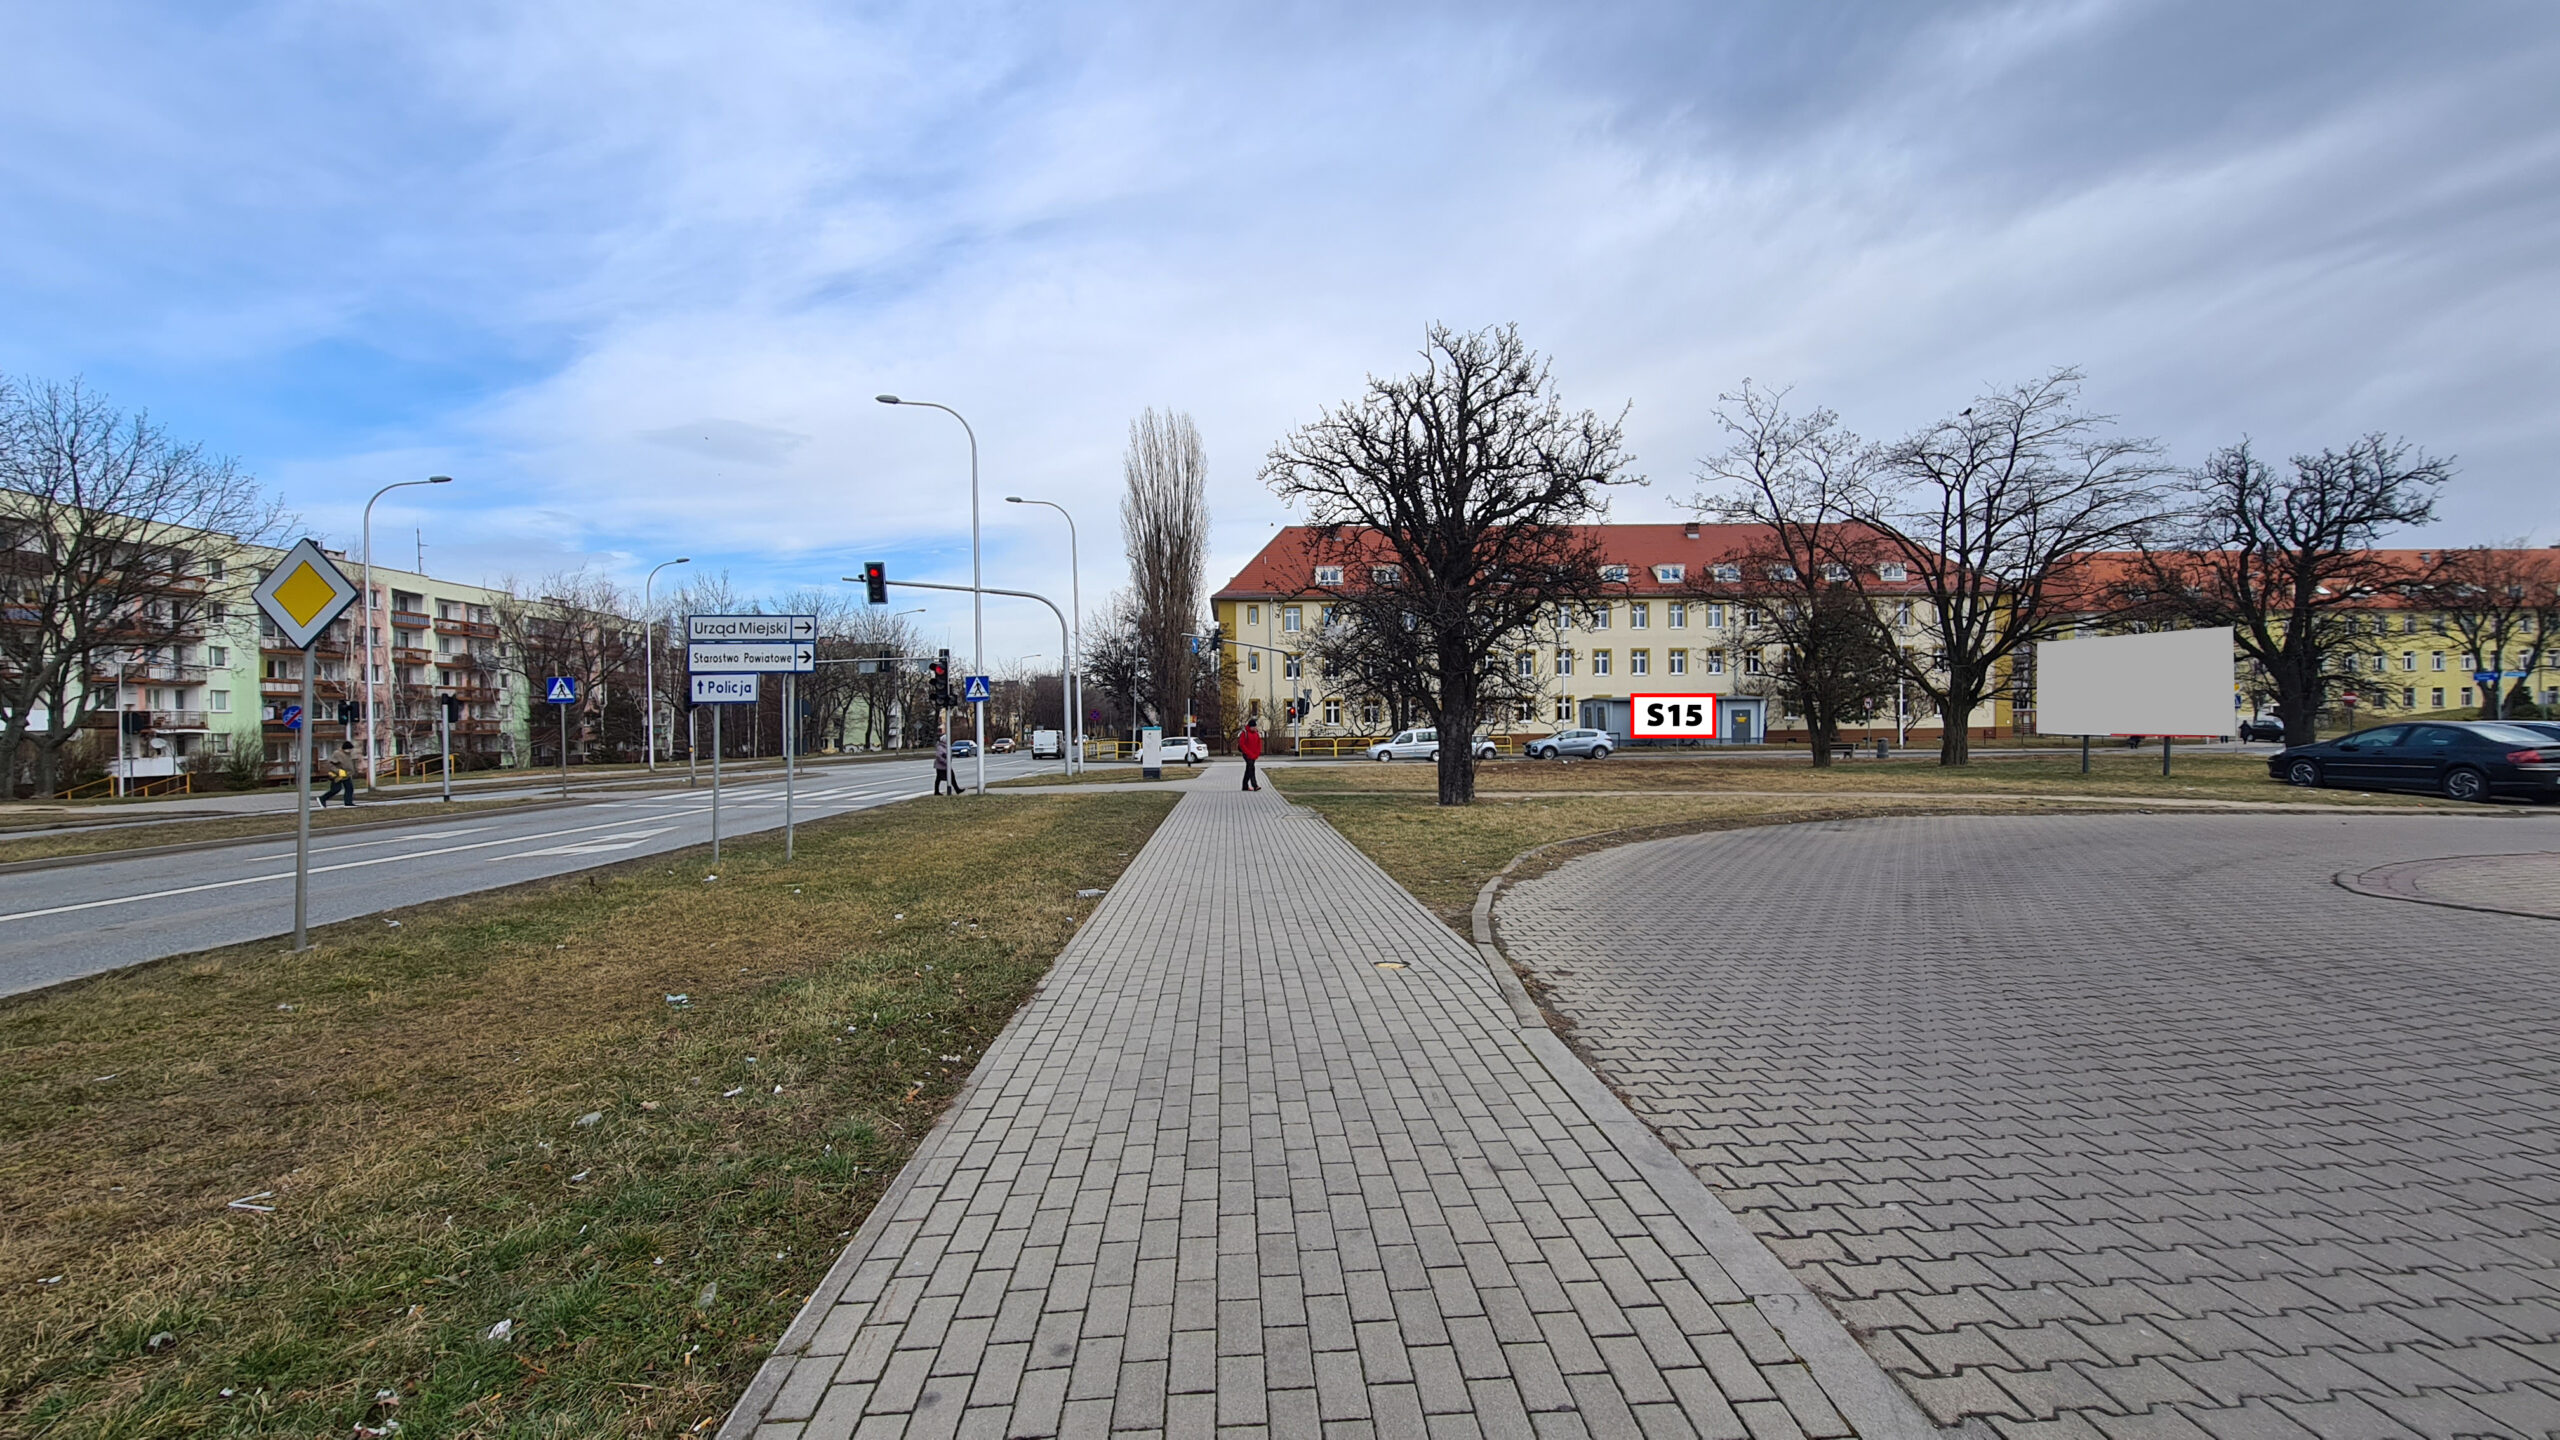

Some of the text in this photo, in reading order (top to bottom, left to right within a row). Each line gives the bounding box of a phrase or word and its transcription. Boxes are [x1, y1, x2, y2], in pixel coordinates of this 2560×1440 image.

[694, 622, 787, 637] Urząd Miejski
[694, 652, 792, 663] Starostwo Powiatowe
[708, 680, 752, 697] Policja
